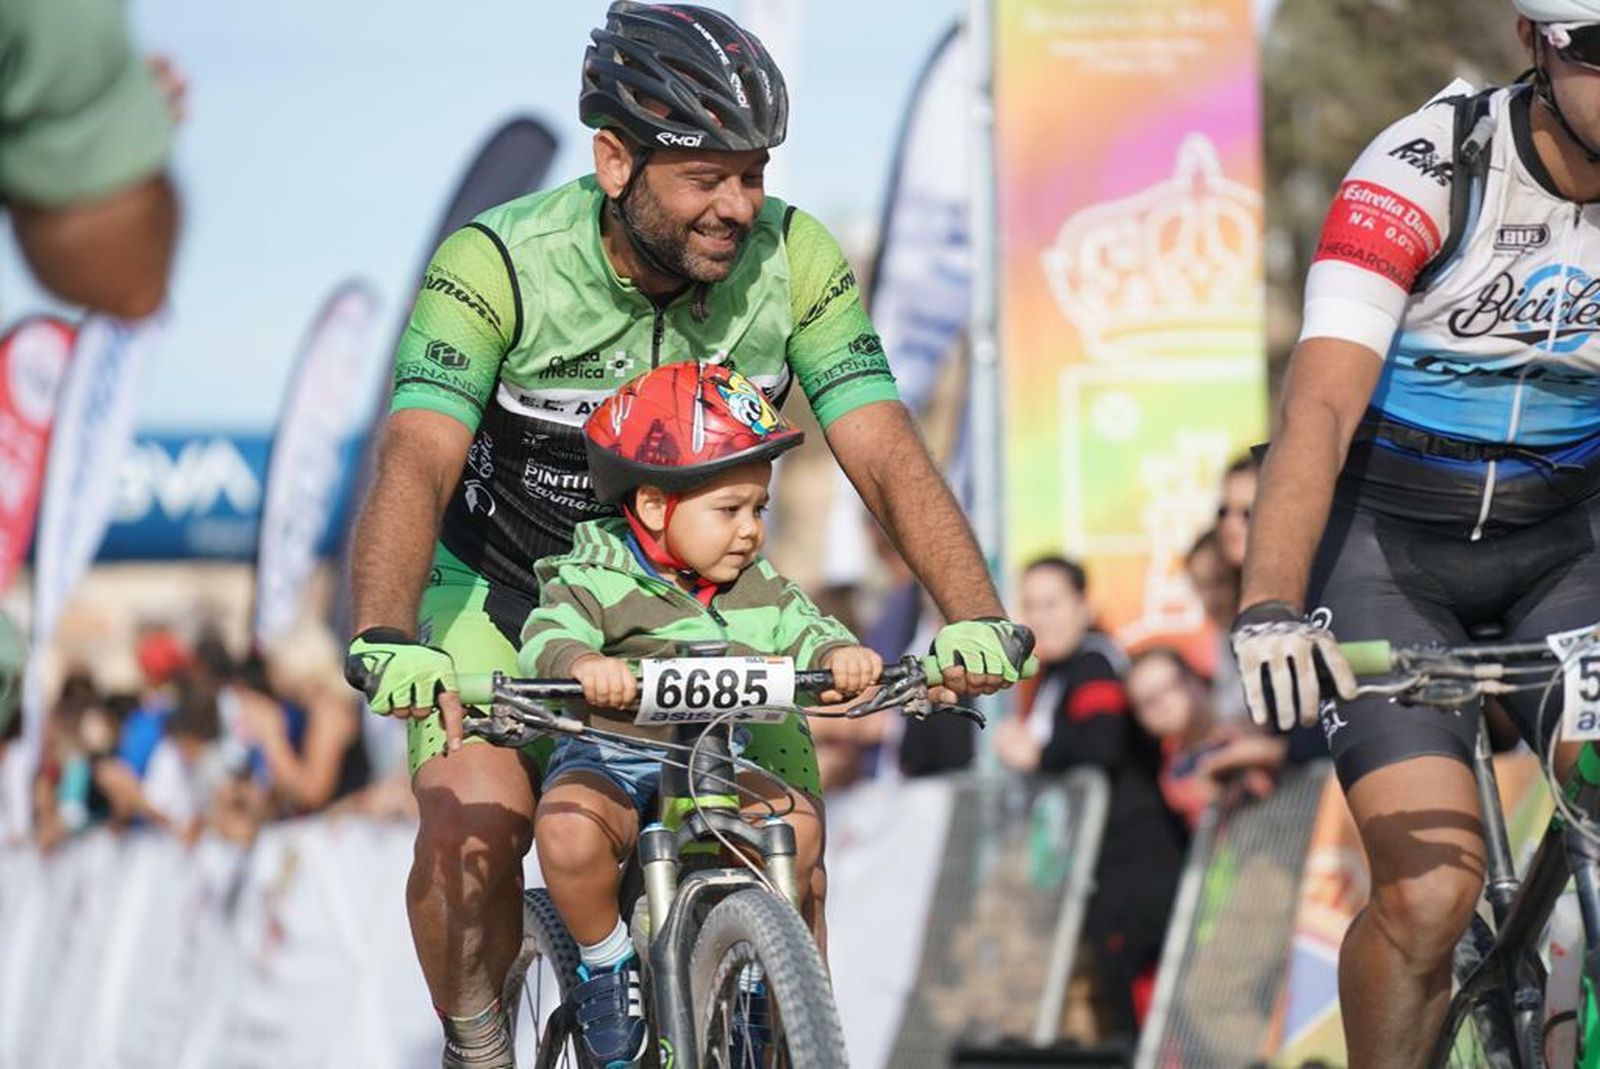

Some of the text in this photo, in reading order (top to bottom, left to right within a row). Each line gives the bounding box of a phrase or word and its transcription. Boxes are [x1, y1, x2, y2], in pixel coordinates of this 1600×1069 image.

[1343, 184, 1405, 216] Estrella
[1448, 271, 1600, 338] Bicicle
[525, 464, 593, 490] PINTU
[655, 668, 769, 709] 6685
